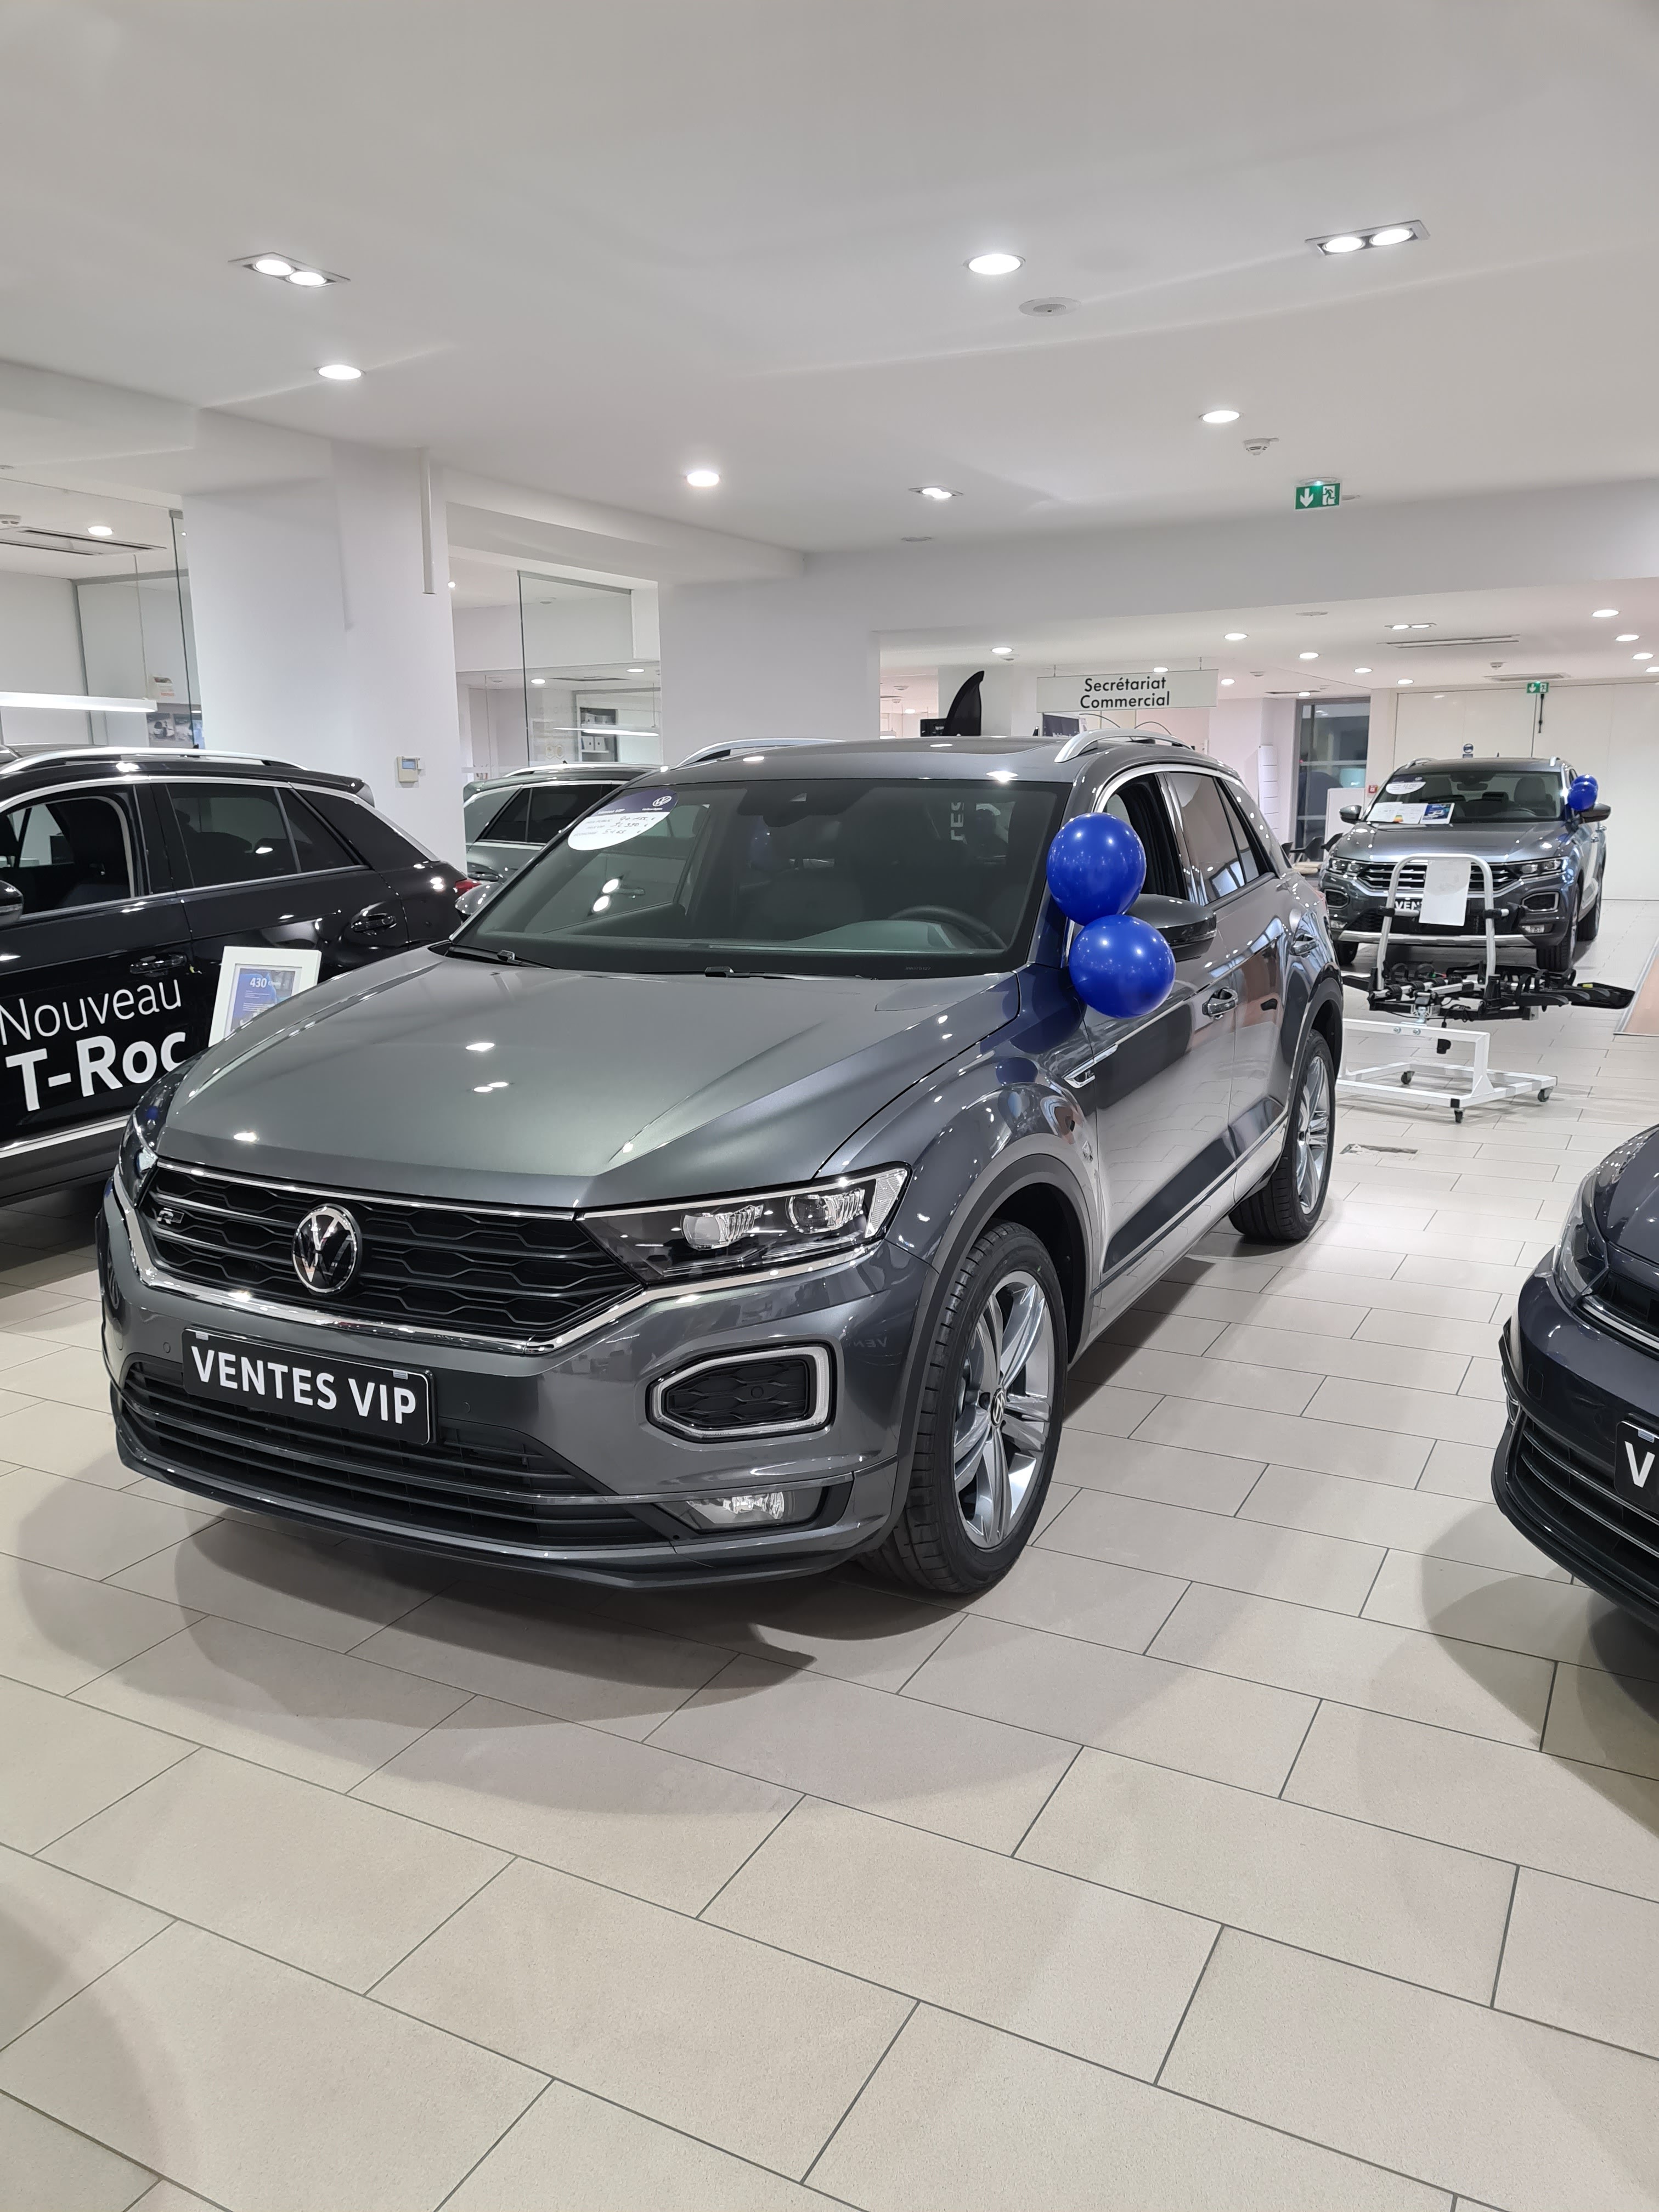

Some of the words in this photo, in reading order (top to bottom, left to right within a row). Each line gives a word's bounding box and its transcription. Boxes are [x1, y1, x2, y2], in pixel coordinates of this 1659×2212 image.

[1080, 691, 1170, 708] Commercial
[1084, 676, 1166, 692] Secrétariat
[250, 977, 267, 988] 430
[0, 979, 182, 1046] Nouveau
[5, 1032, 187, 1111] T-Roc
[191, 1346, 337, 1410] VENTES
[348, 1378, 416, 1424] VIP
[1624, 1441, 1656, 1488] V
